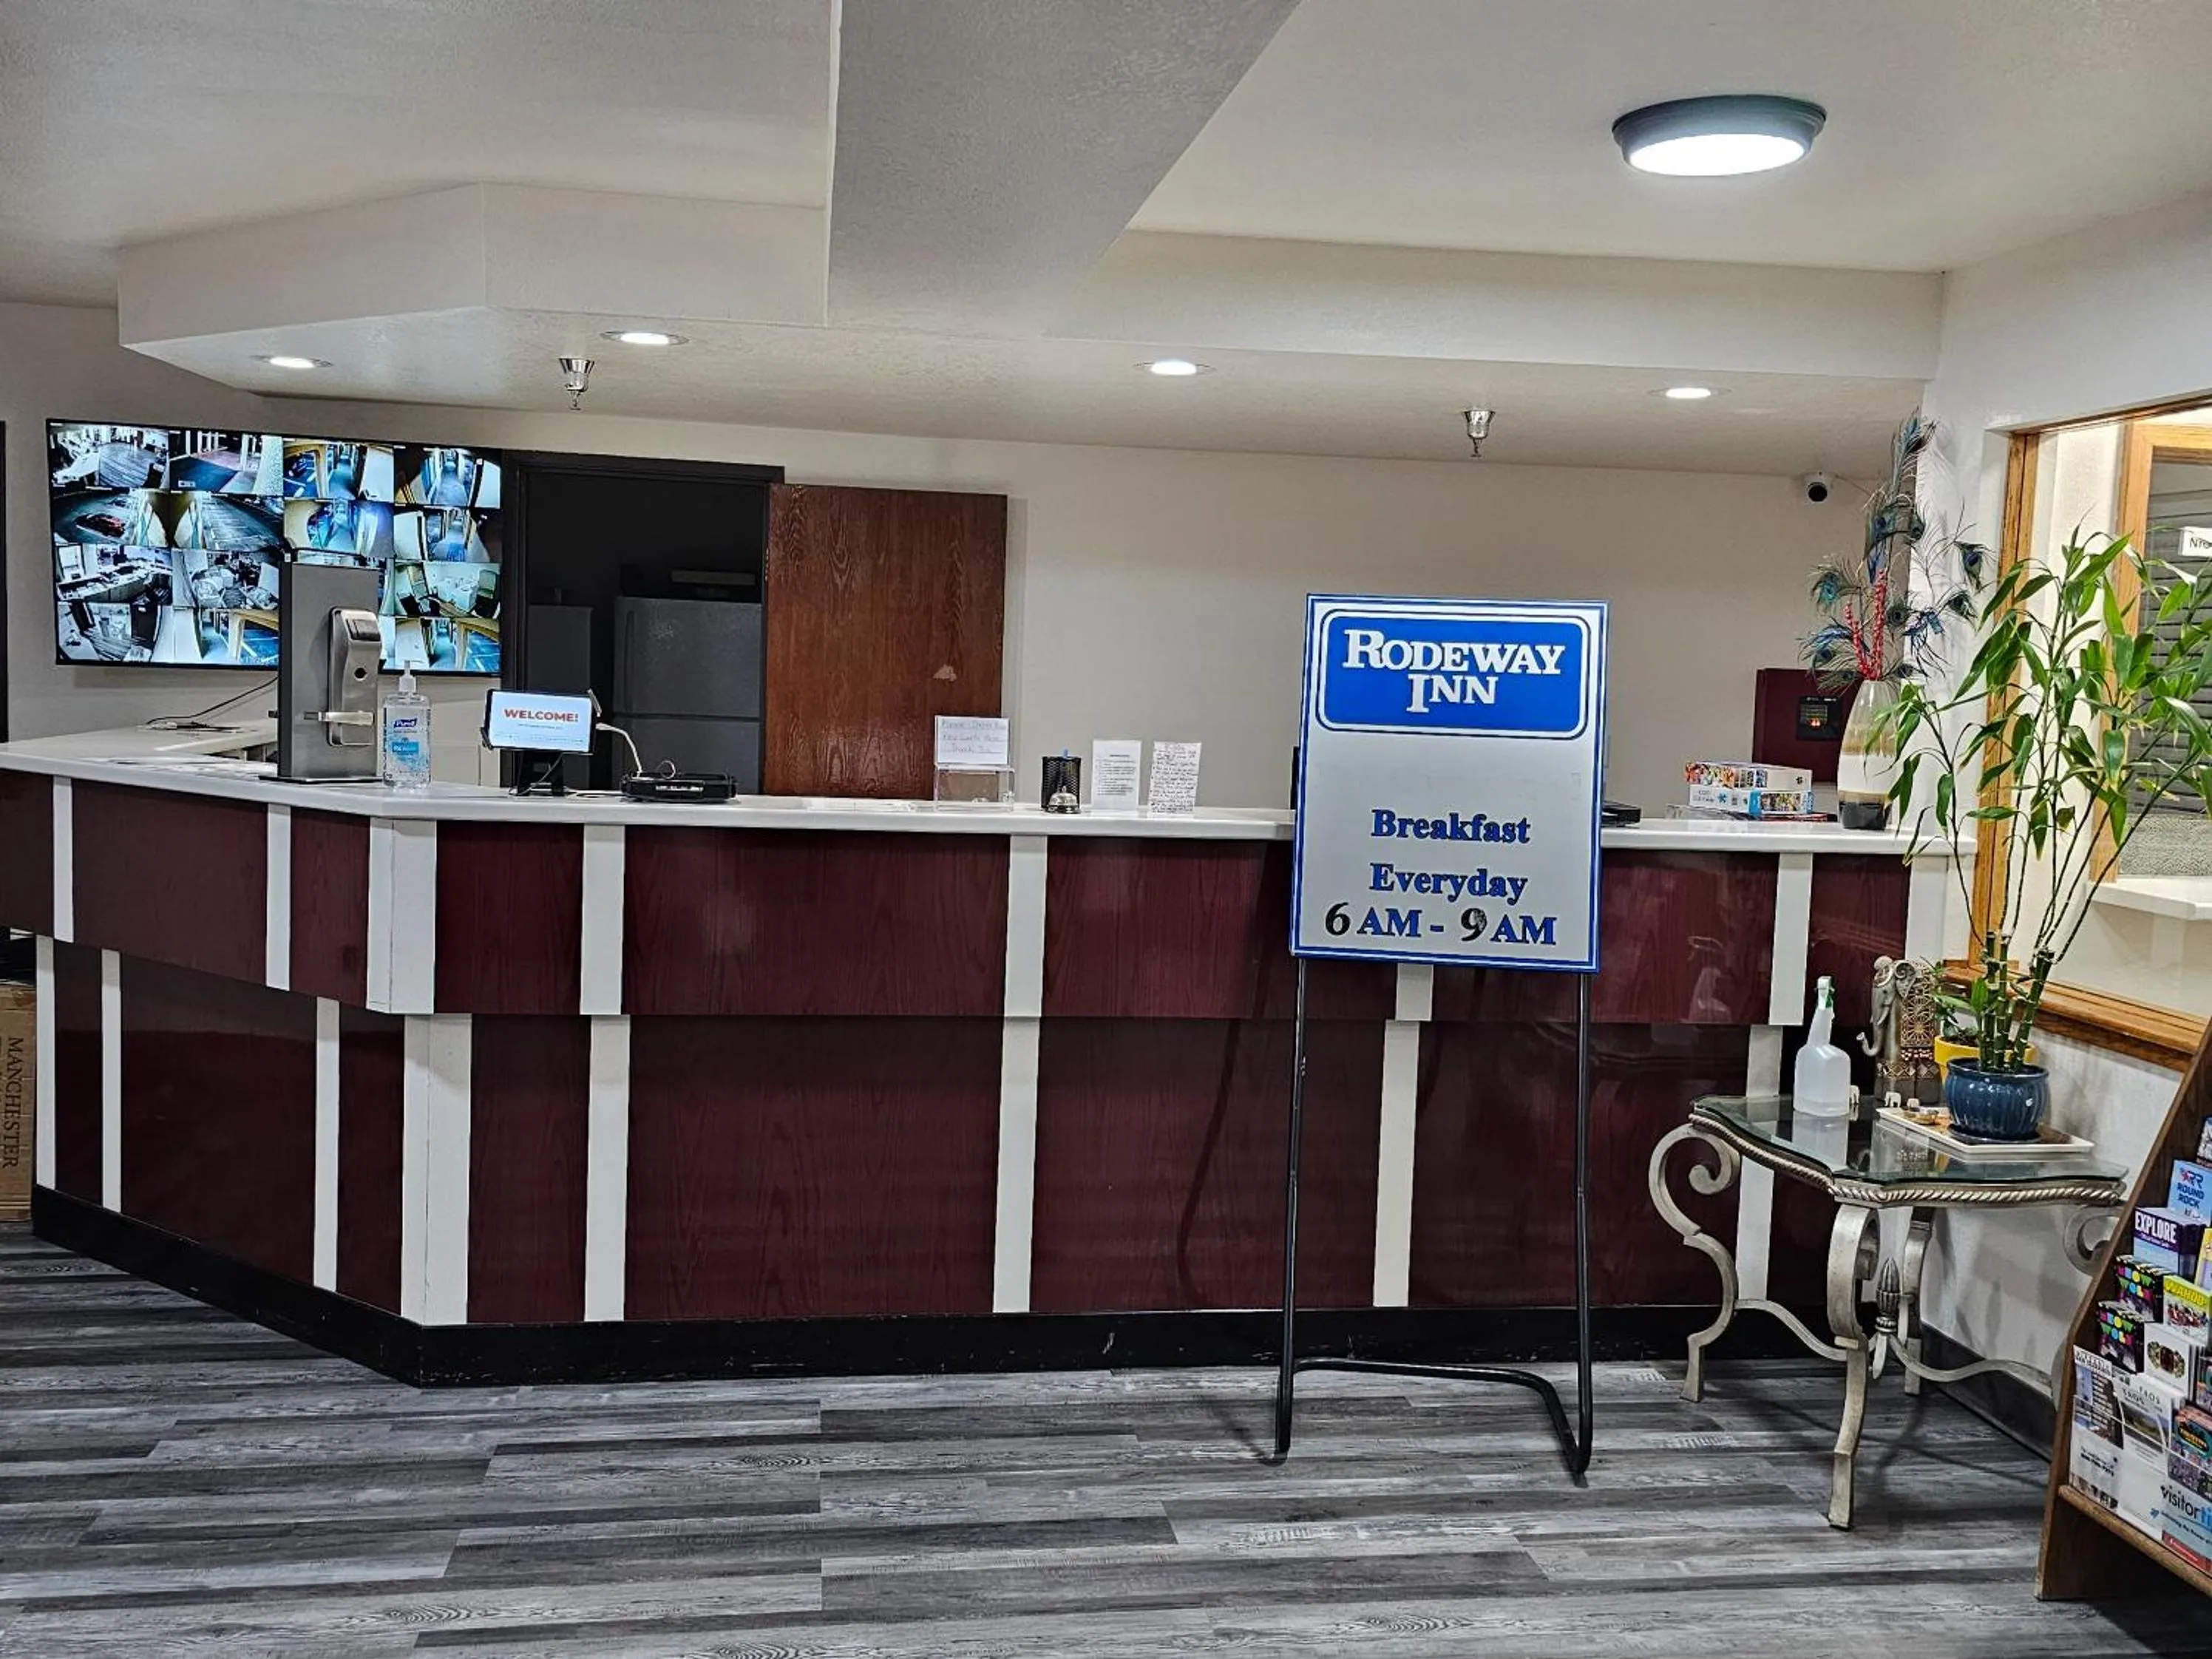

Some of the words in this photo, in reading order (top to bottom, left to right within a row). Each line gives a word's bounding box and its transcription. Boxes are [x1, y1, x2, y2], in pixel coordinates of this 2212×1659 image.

[1343, 629, 1565, 674] RODEWAY
[1406, 674, 1499, 713] INN
[504, 709, 579, 722] WELCOME!
[1371, 809, 1531, 844] Breakfast
[1369, 863, 1528, 906] Everyday
[2, 1037, 24, 1169] MANCHESTER
[2135, 1210, 2177, 1244] EXPLORE
